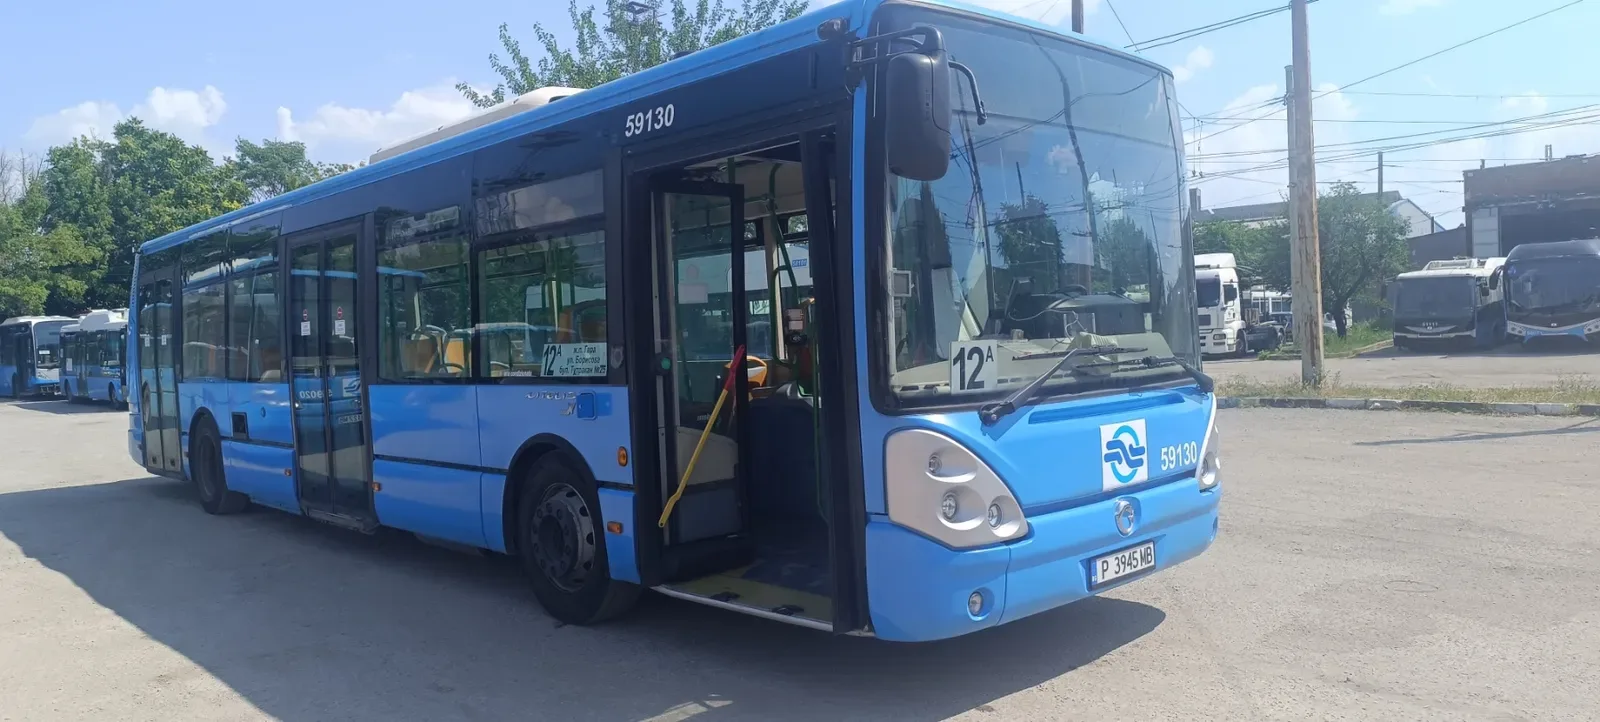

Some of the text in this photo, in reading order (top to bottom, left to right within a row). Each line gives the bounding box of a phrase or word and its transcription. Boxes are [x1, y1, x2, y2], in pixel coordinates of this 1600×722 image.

[625, 103, 674, 137] 59130
[1160, 440, 1197, 471] 59130
[1101, 559, 1109, 579] P
